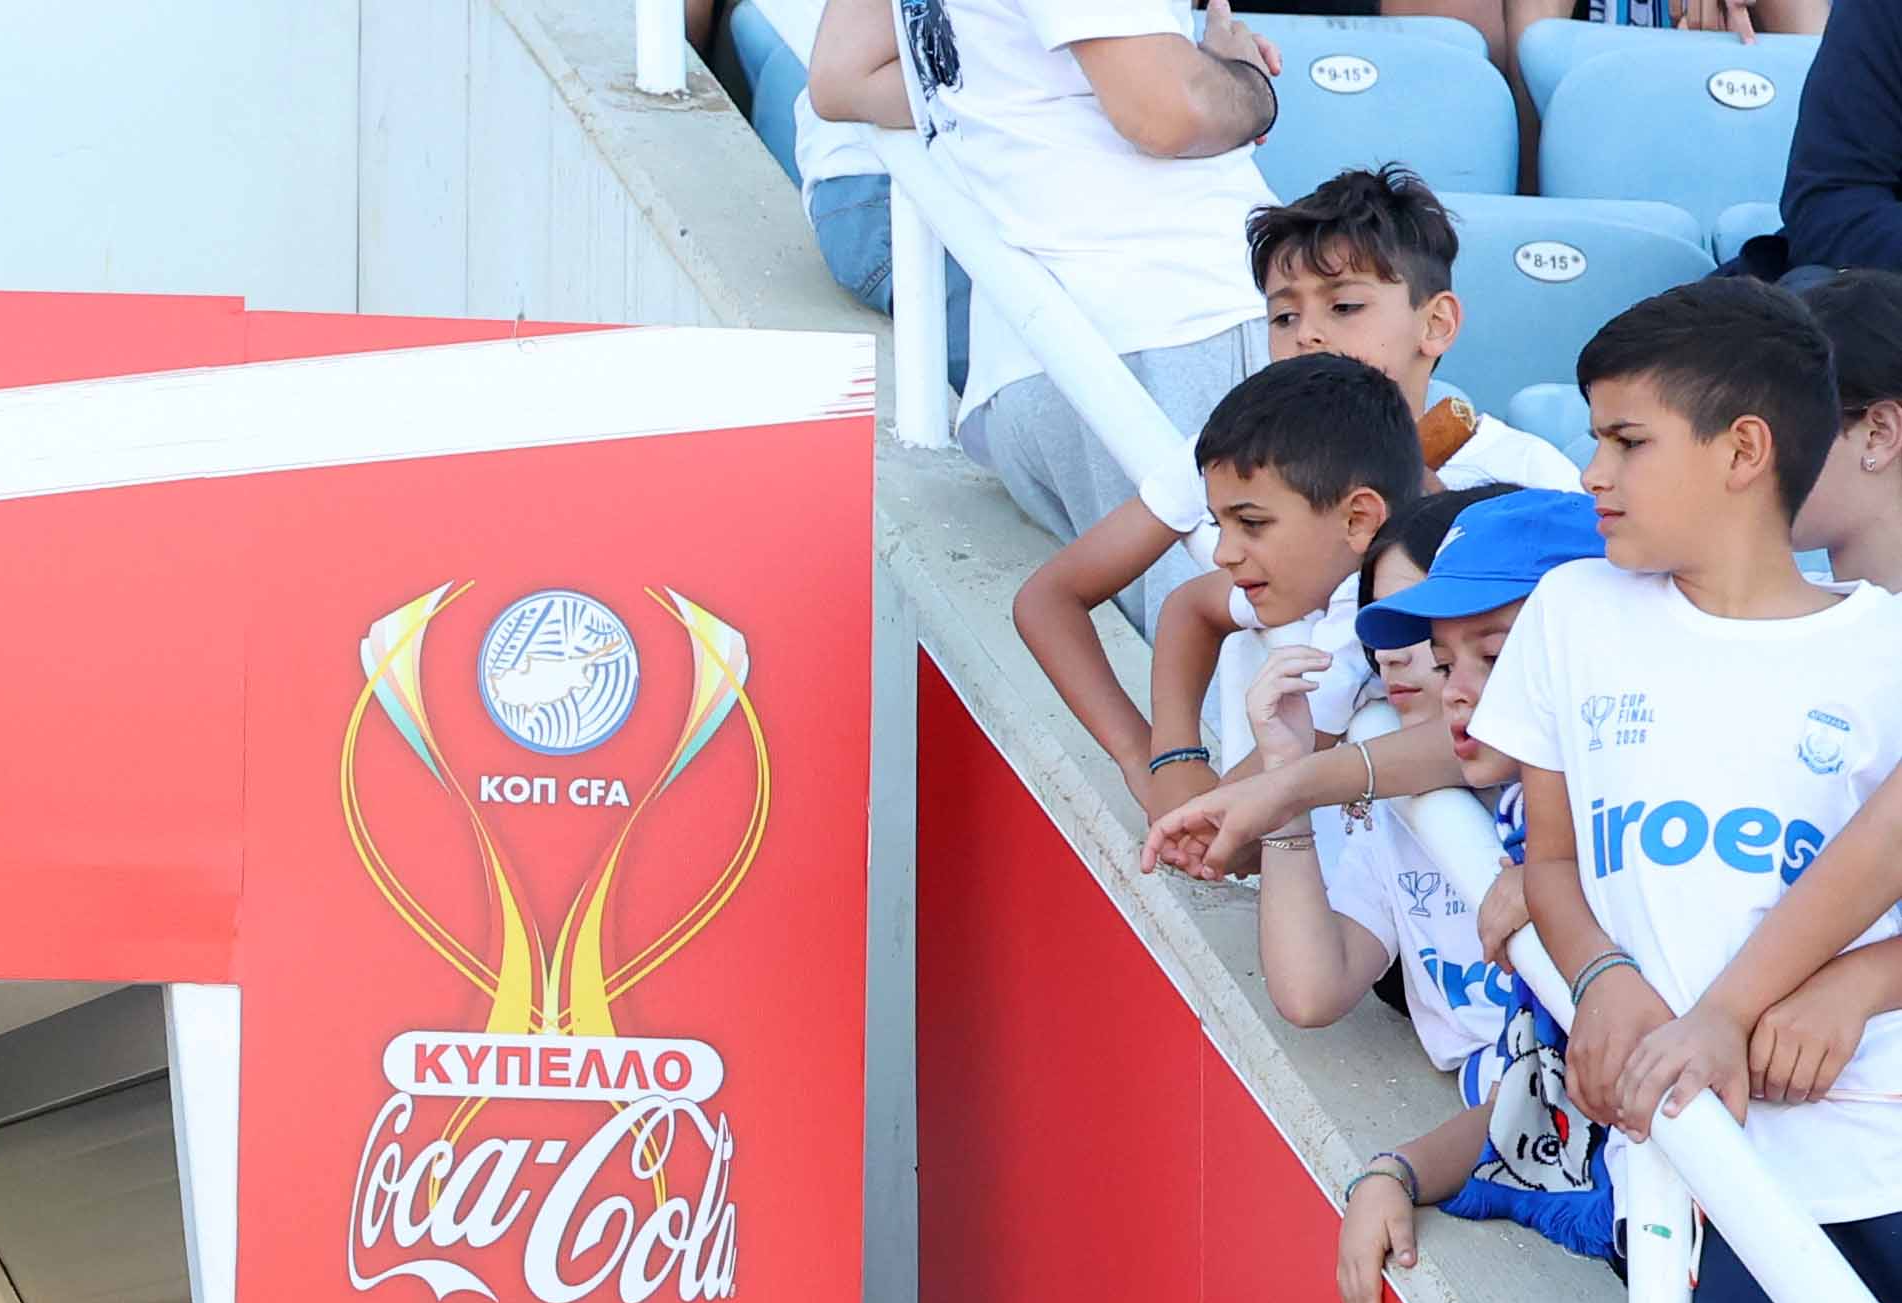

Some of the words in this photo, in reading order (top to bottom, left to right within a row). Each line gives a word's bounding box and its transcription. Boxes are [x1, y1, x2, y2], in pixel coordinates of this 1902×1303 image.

[1327, 66, 1362, 81] 9-15
[1533, 253, 1570, 271] 8-15
[1620, 692, 1647, 708] CUP
[1617, 708, 1655, 724] FINAL
[1615, 728, 1647, 745] 2026
[480, 775, 557, 804] ΚΟΠ
[568, 778, 631, 807] CFA
[413, 1043, 693, 1092] ΚΥΠΕΛΛΟ
